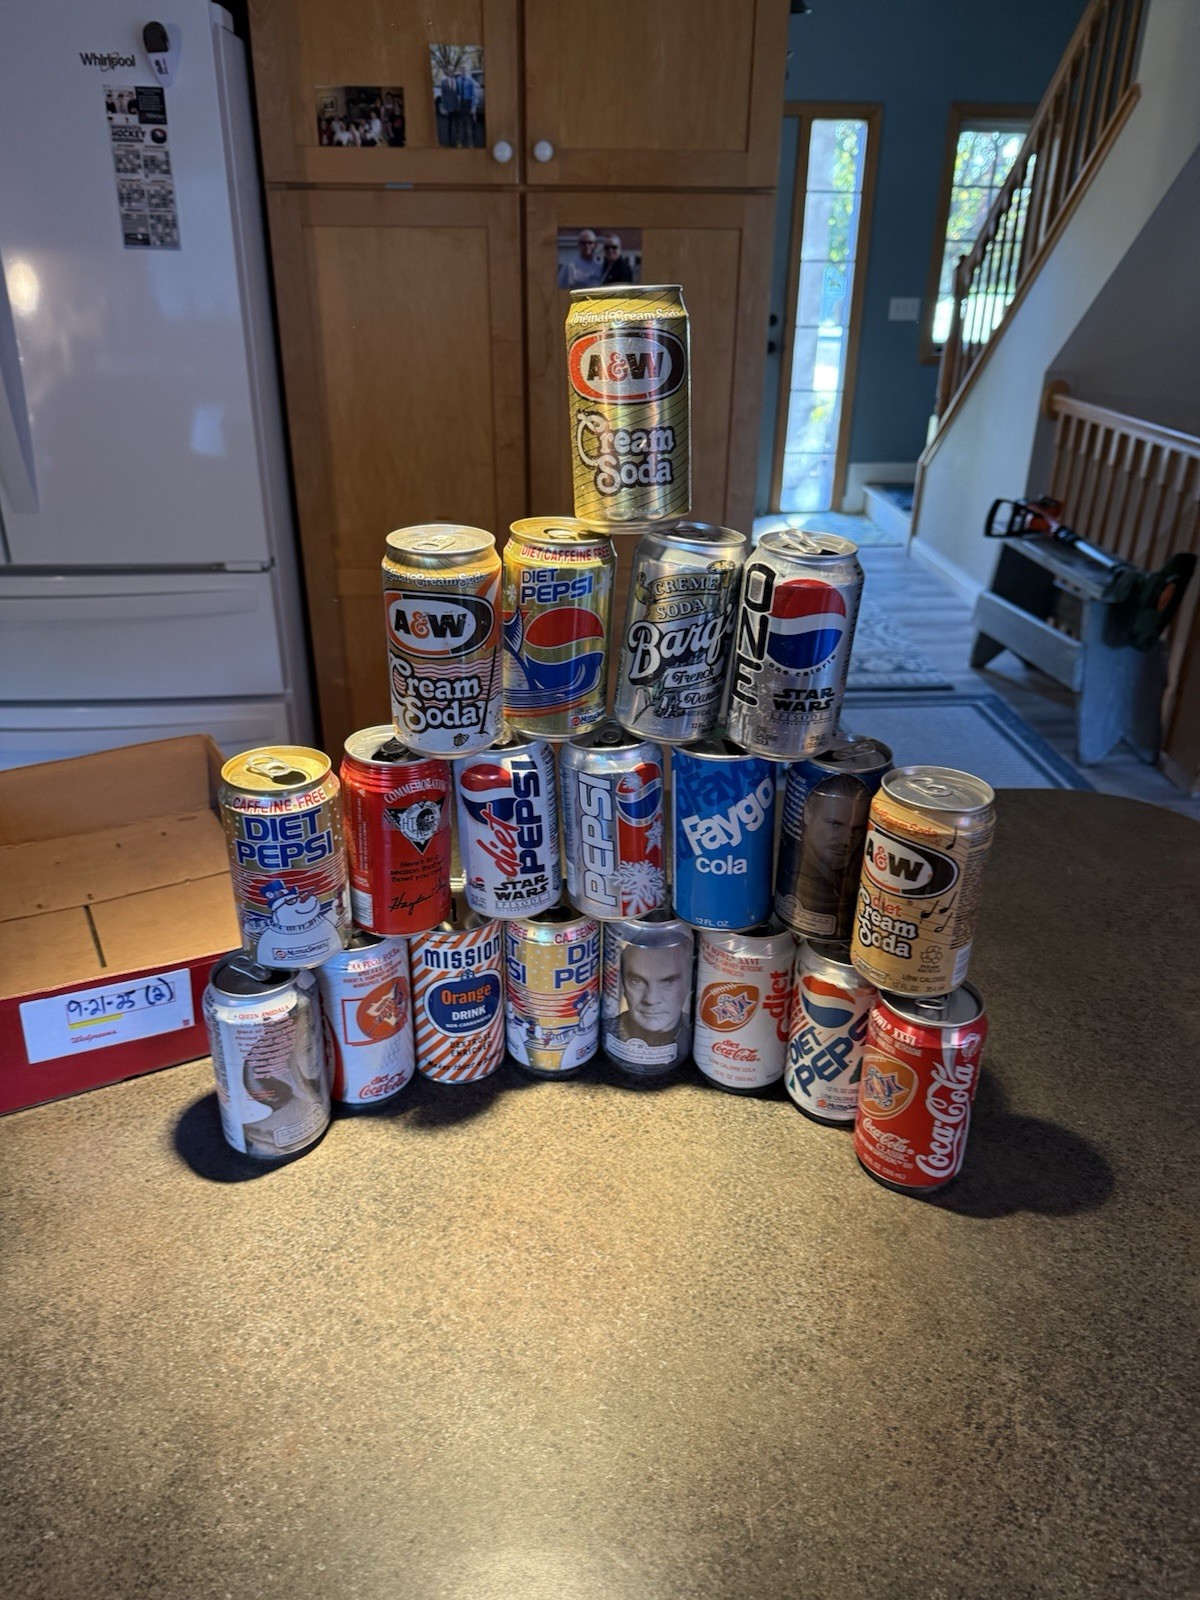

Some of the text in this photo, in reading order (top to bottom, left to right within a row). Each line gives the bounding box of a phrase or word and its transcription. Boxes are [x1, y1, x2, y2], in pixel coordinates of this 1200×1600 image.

[80, 52, 136, 71] Whirlpool
[112, 130, 146, 139] HOCKEY
[587, 352, 664, 381] A&W
[576, 410, 675, 468] Cream
[594, 455, 674, 495] Soda
[521, 545, 610, 562] DIET CAFFEINE FREE
[521, 575, 594, 604] PEPSI
[522, 568, 558, 584] DIET
[653, 574, 719, 595] CREME
[394, 609, 467, 640] A&W
[656, 601, 706, 620] SODA
[628, 603, 737, 687] Barq's
[390, 651, 481, 706] Cream
[769, 655, 836, 677] one calorie
[772, 698, 834, 713] WARS
[773, 687, 835, 700] STAR
[295, 789, 327, 809] FREE
[244, 808, 322, 842] DIET
[511, 760, 546, 874] PEPSI
[681, 778, 774, 856] Faygo
[235, 830, 334, 869] PEPSI
[476, 802, 523, 877] diet
[578, 771, 618, 907] PEPSI
[695, 855, 748, 875] cola
[865, 838, 925, 882] A&W
[493, 874, 549, 891] STAR
[494, 882, 549, 901] WARS
[856, 885, 918, 940] Cream
[872, 895, 902, 916] diet
[509, 922, 528, 939] FREE
[858, 920, 911, 959] Soda
[424, 934, 500, 969] MISSION
[567, 936, 599, 966] DIE
[554, 958, 599, 989] PEP
[145, 978, 173, 1006] (2)
[441, 984, 492, 1005] Orange
[762, 969, 790, 1019] diet
[452, 1005, 486, 1021] DRINK
[789, 1026, 822, 1065] DIET
[892, 1027, 917, 1047] XXVI
[711, 1042, 758, 1062] Coca-Cola
[359, 1071, 408, 1100] Coca-Cola
[915, 1061, 975, 1179] Coca-Cola
[863, 1118, 911, 1153] Coca-Cola
